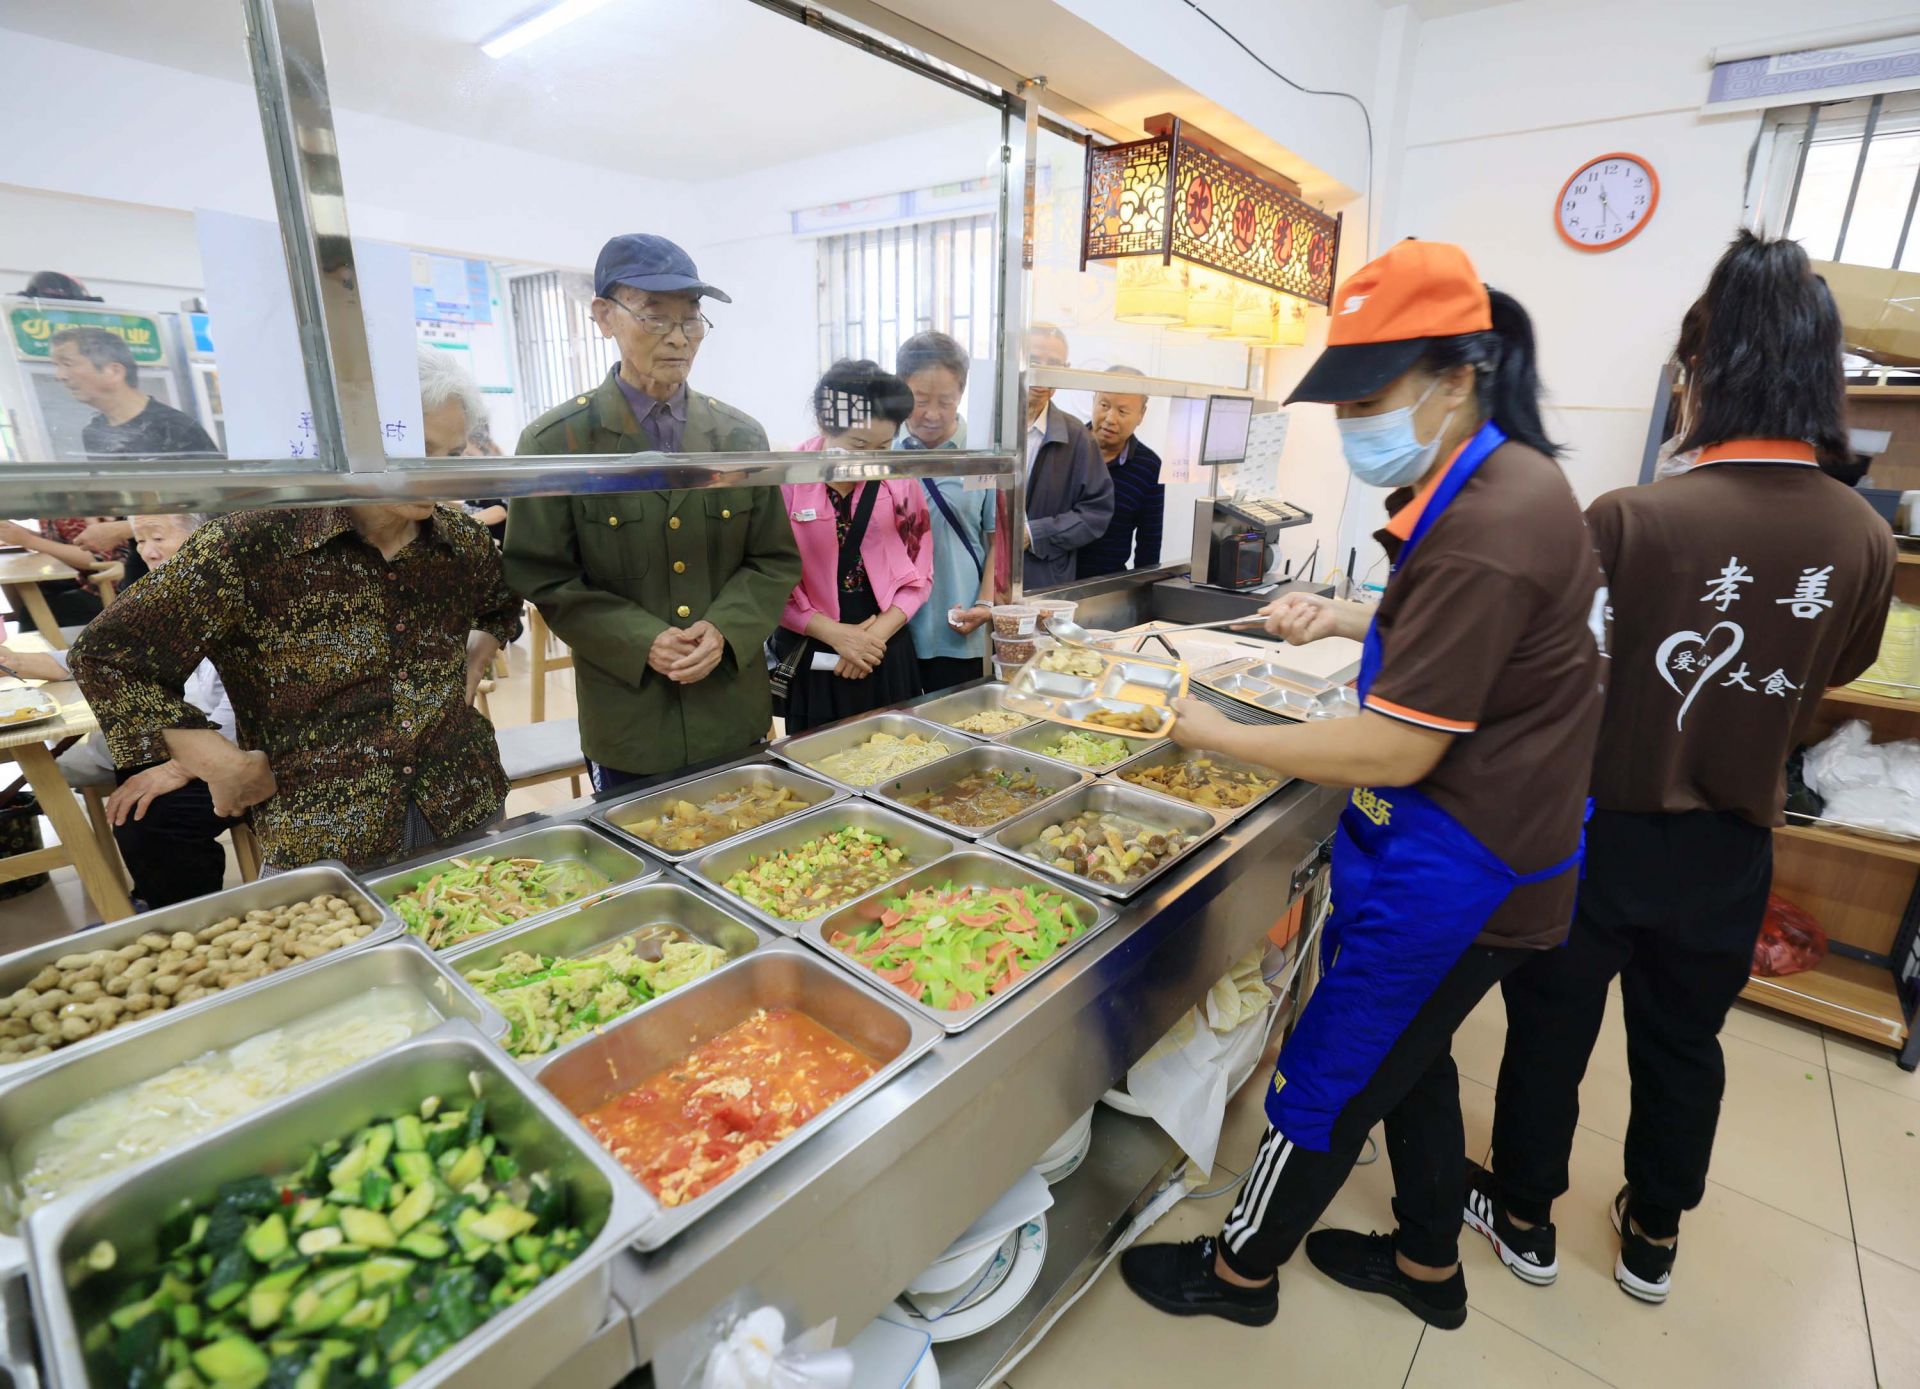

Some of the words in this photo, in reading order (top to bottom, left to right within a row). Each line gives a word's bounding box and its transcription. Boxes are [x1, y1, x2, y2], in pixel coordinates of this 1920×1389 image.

[1604, 164, 1619, 175] 12
[1625, 167, 1631, 178] 1
[1588, 172, 1599, 182] 11
[1633, 178, 1643, 188] 2
[1574, 184, 1588, 195] 10
[1634, 195, 1645, 205] 3
[1566, 201, 1576, 211] 9
[1626, 210, 1636, 221] 4
[1569, 217, 1579, 226] 8
[1580, 228, 1589, 238] 7
[1613, 223, 1623, 233] 5
[1594, 229, 1605, 240] 6
[1719, 661, 1806, 702] 大食
